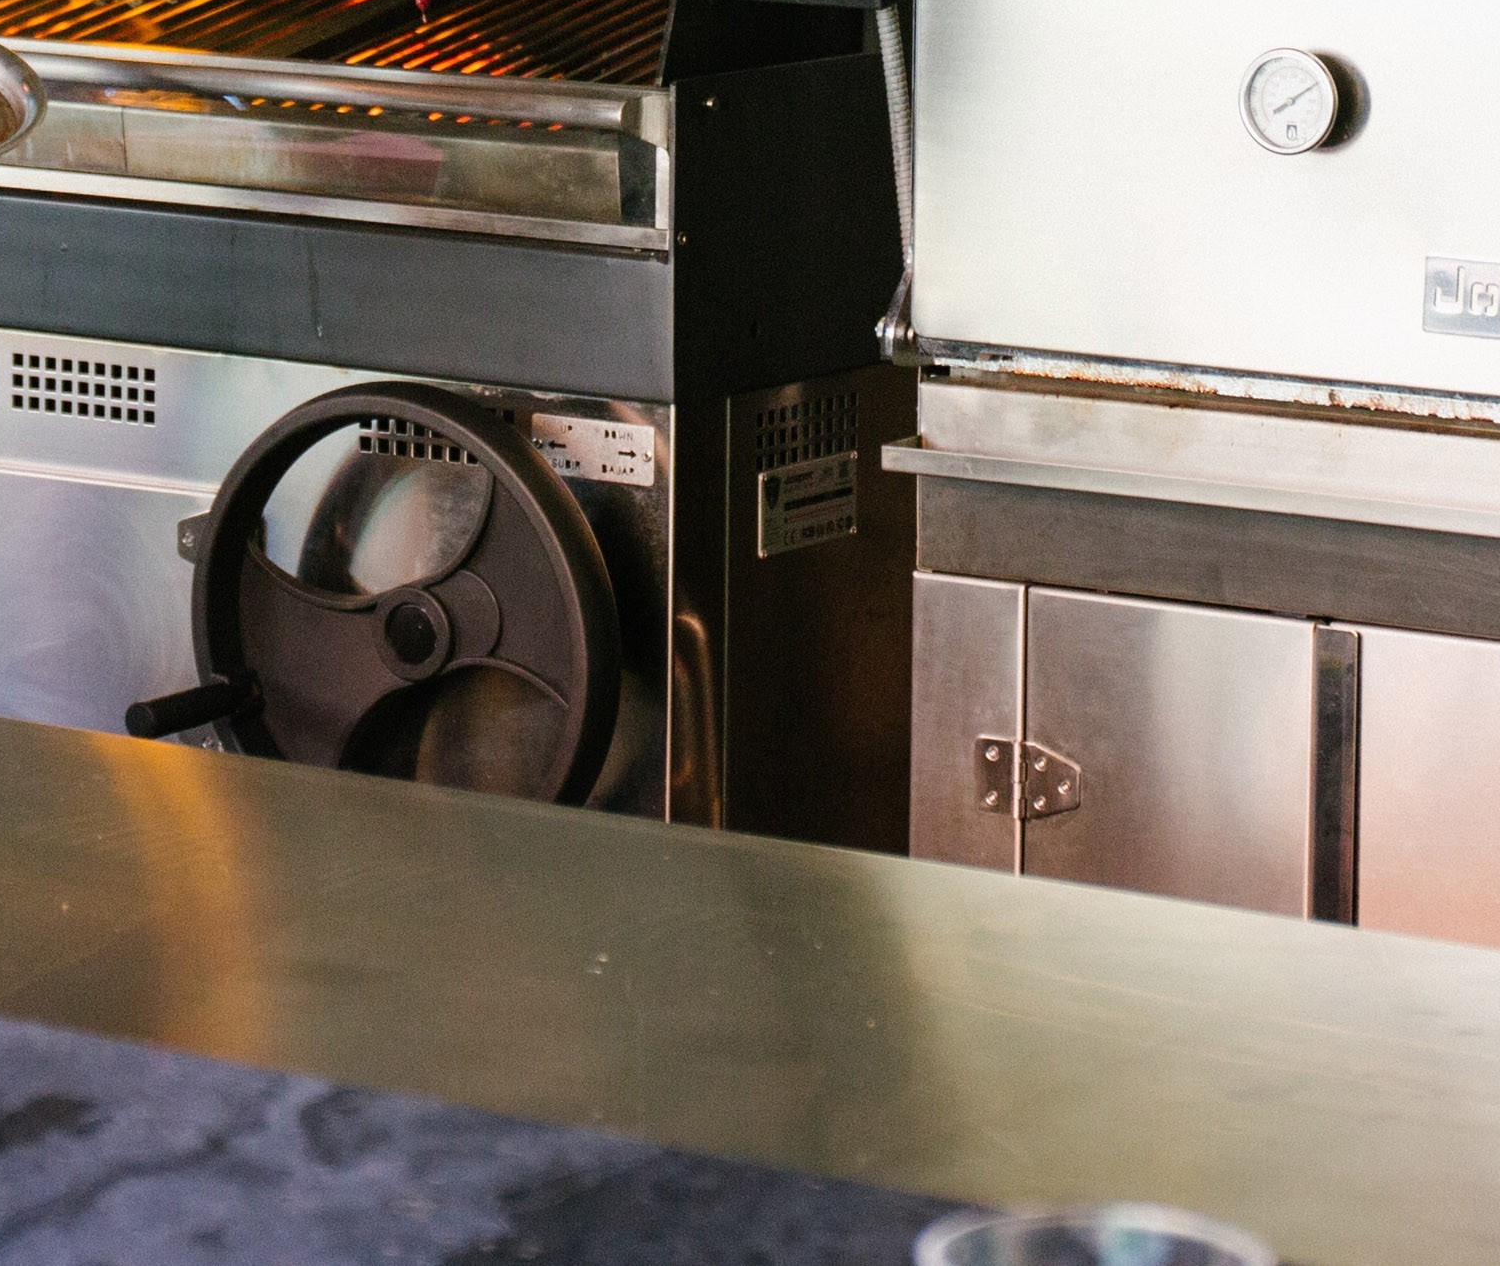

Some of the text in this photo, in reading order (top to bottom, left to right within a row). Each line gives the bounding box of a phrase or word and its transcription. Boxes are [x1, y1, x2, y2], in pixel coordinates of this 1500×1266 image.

[561, 424, 573, 434] UP
[604, 429, 633, 441] DOWN
[551, 457, 580, 471] SUBIR
